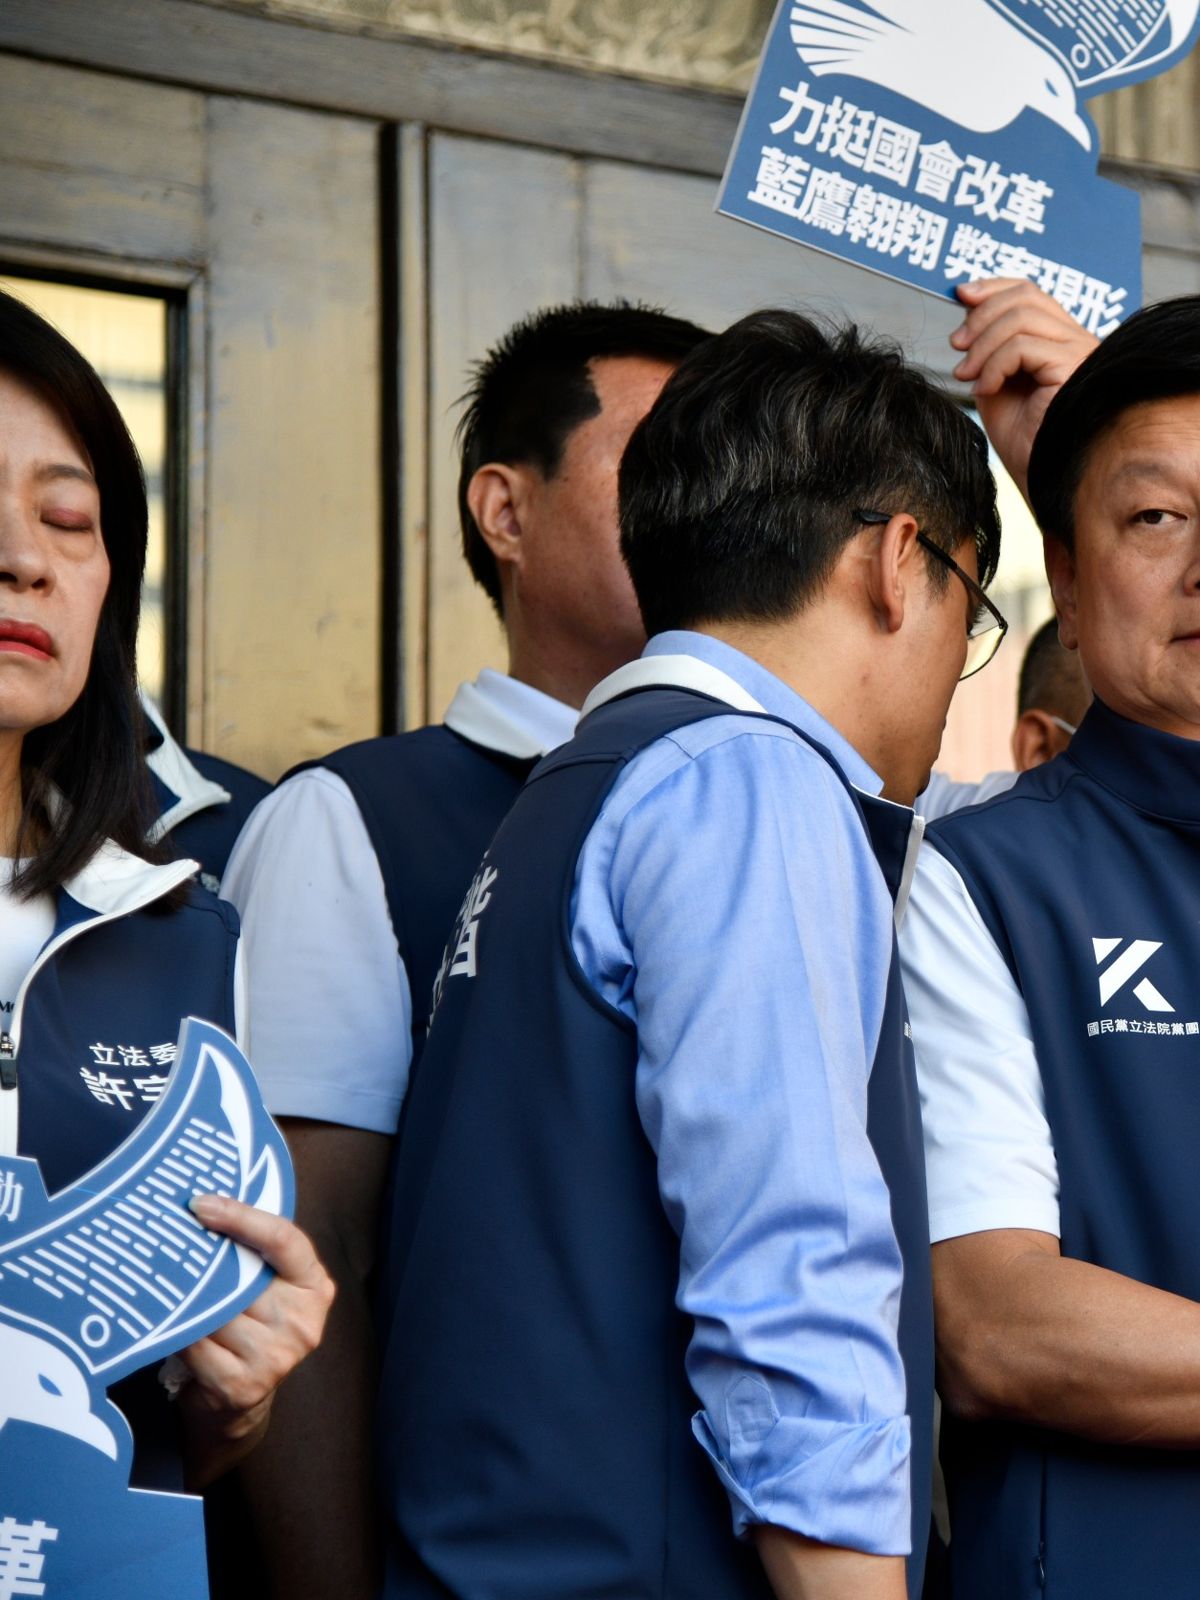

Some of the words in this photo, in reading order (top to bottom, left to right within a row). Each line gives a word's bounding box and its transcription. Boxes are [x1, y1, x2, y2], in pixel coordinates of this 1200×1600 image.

[747, 145, 949, 271] 藍鷹翱翔
[769, 80, 1054, 235] 力挺國會改革
[1086, 1018, 1200, 1037] 國民黨立法院黨團
